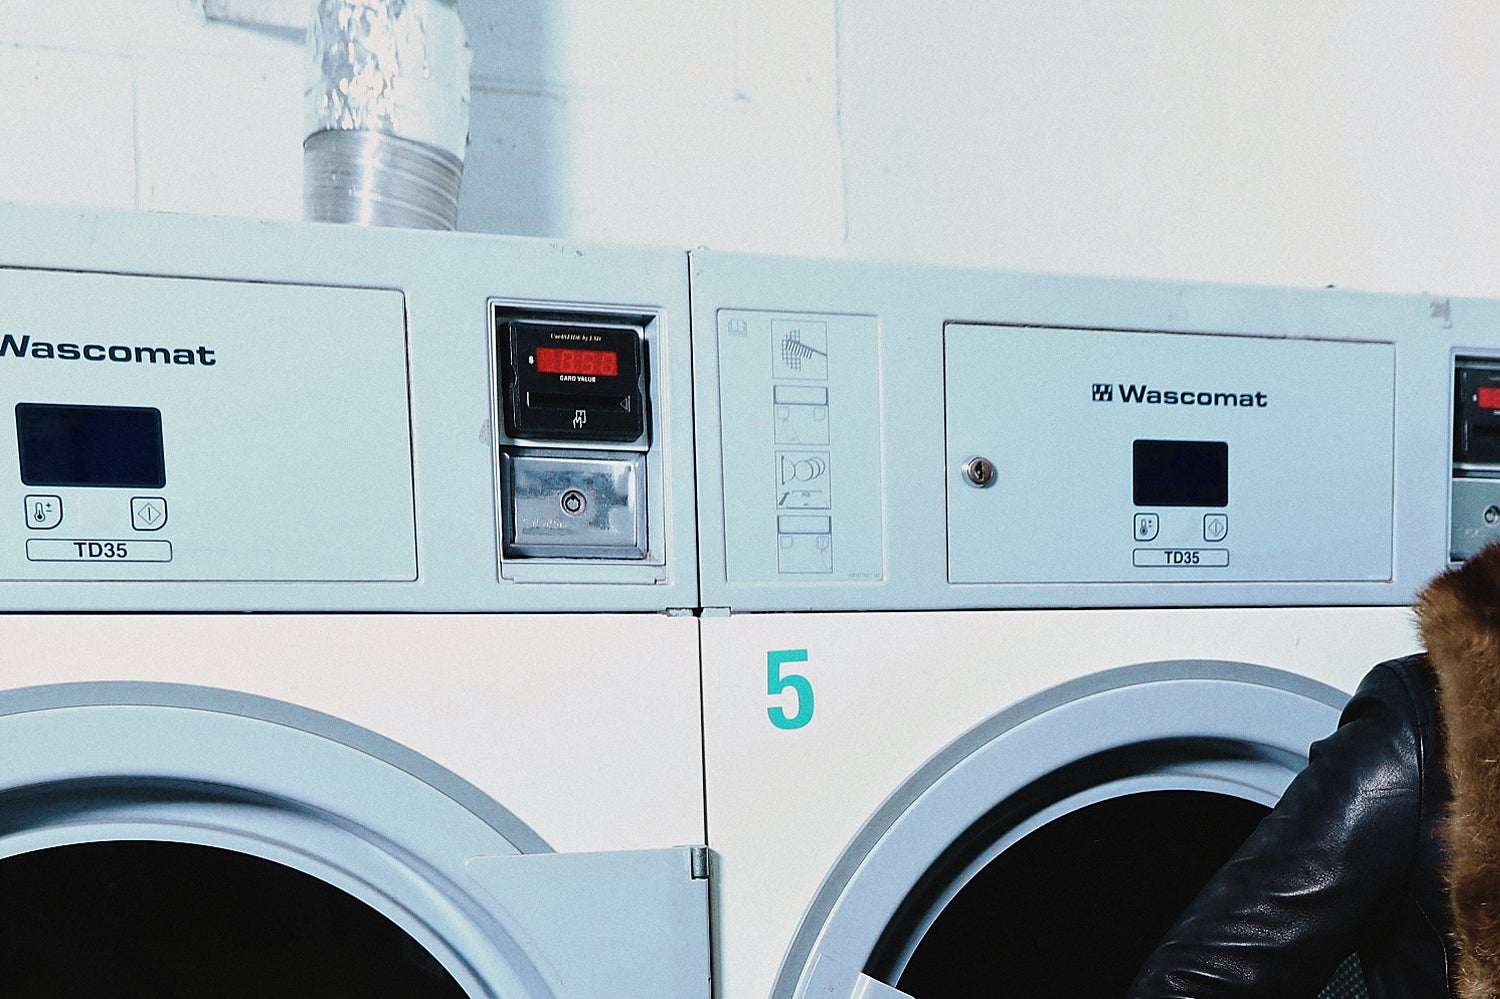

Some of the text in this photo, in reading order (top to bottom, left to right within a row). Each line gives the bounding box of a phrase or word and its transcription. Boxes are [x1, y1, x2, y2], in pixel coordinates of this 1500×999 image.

[577, 375, 597, 383] VALUE
[1118, 383, 1268, 408] Wascomat
[73, 542, 128, 558] TD35
[1164, 551, 1200, 564] TD35
[766, 648, 815, 730] 5
